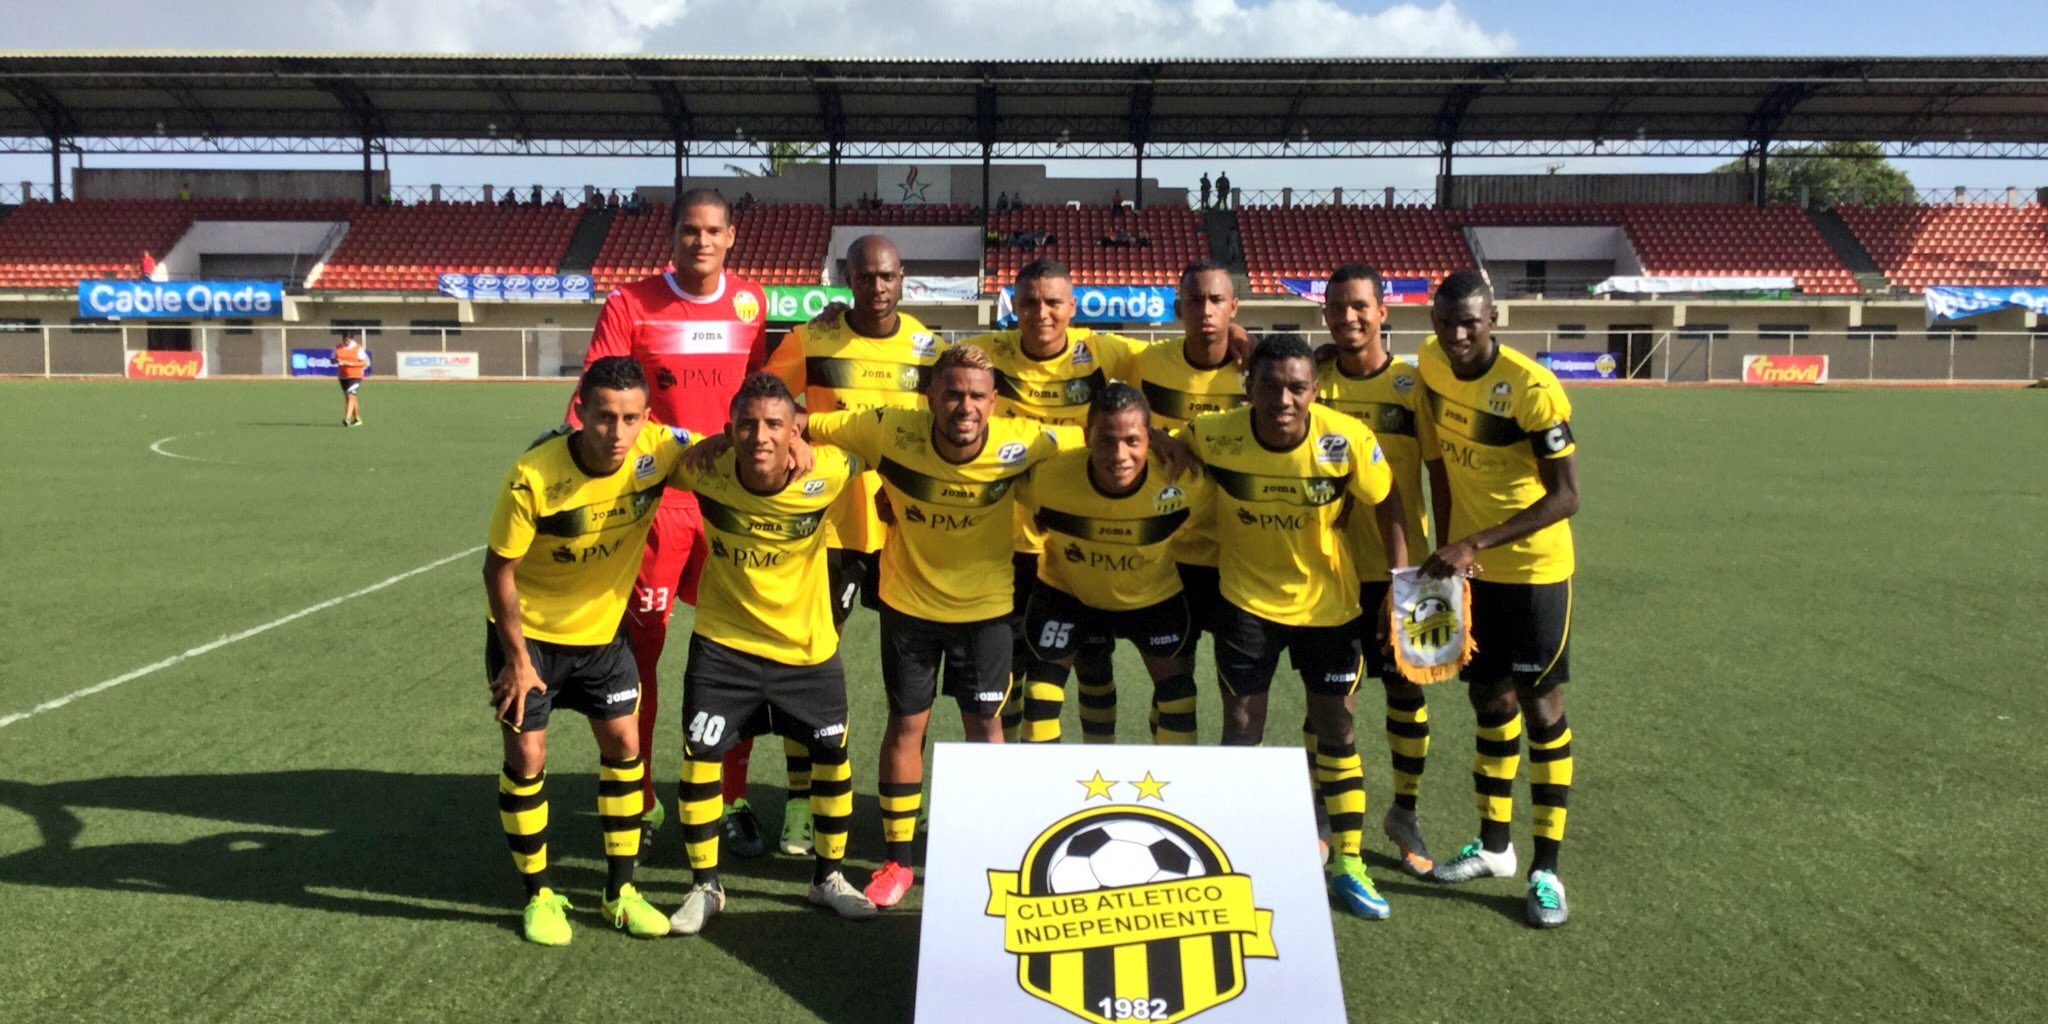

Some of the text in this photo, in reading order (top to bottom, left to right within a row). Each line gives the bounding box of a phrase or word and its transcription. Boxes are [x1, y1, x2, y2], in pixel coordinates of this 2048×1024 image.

[90, 285, 272, 312] Cable Onda
[1081, 291, 1165, 317] Onda
[1546, 428, 1566, 451] C
[1260, 513, 1310, 530] PMC
[733, 547, 791, 569] PMC
[1090, 551, 1145, 572] PMC
[639, 587, 669, 612] 33
[1039, 620, 1075, 648] 65
[689, 710, 726, 747] 40
[1017, 884, 1223, 921] CLUB ATLETICO
[1016, 908, 1230, 945] INDEPENDIENTE
[1098, 998, 1168, 1020] 1982
